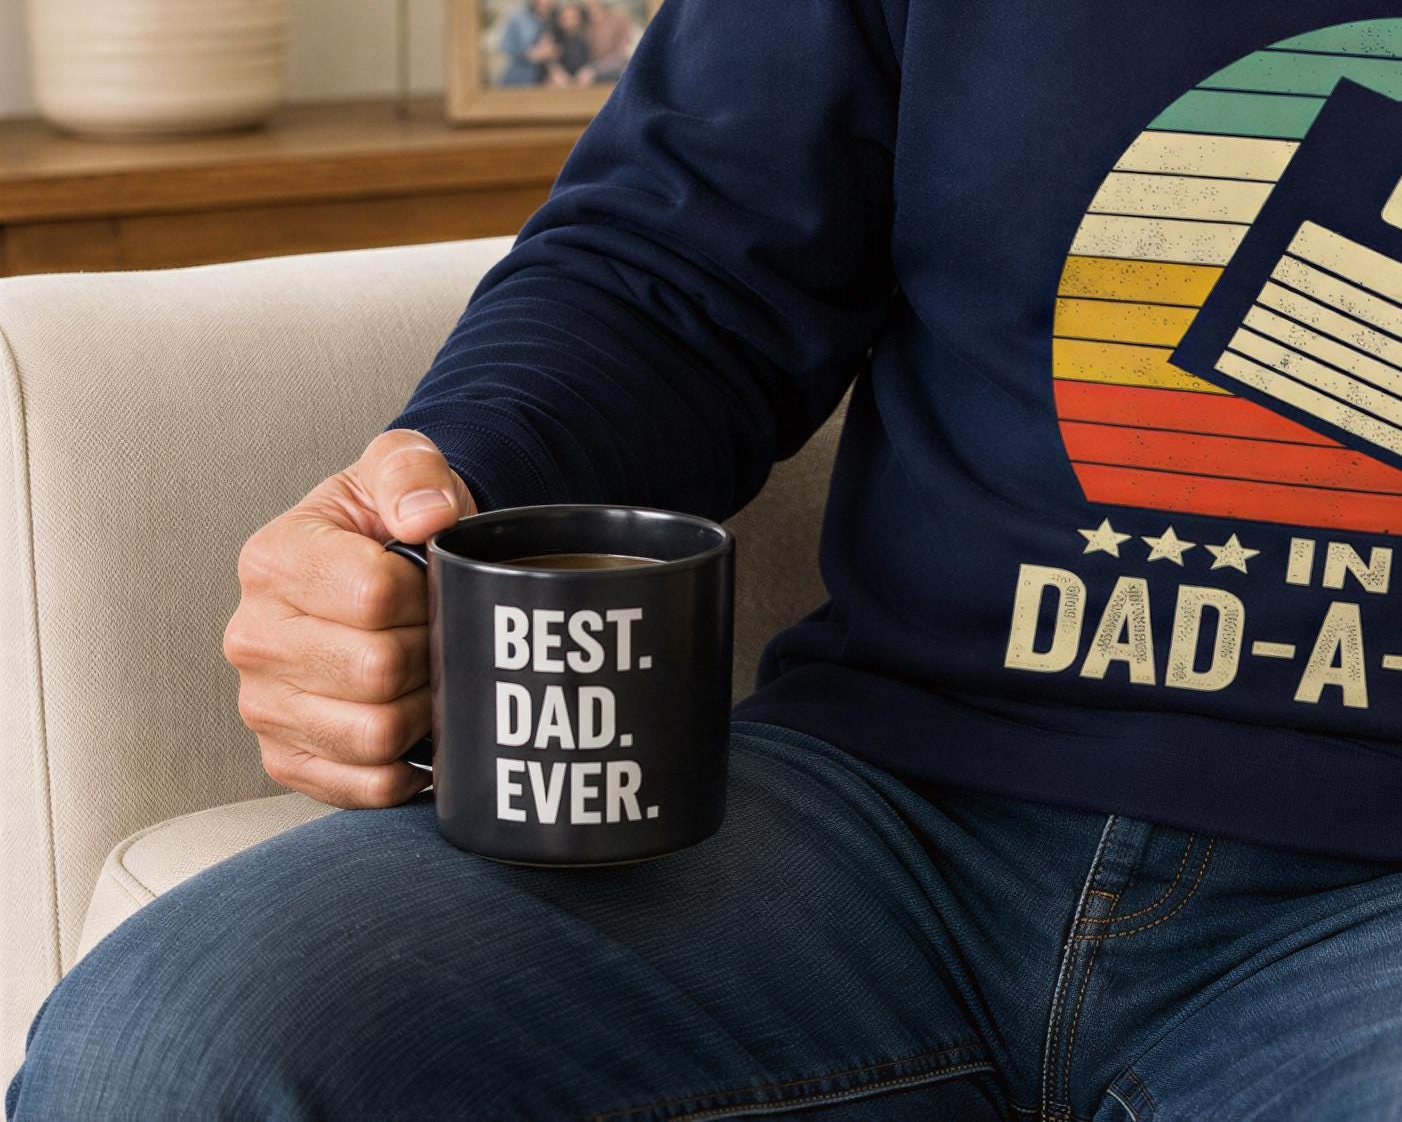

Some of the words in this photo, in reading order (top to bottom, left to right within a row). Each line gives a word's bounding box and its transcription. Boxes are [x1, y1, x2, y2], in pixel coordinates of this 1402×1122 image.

[1285, 537, 1393, 595] IN
[494, 604, 653, 674] BEST.
[495, 681, 634, 750] DAD.
[496, 757, 660, 826] EVER.
